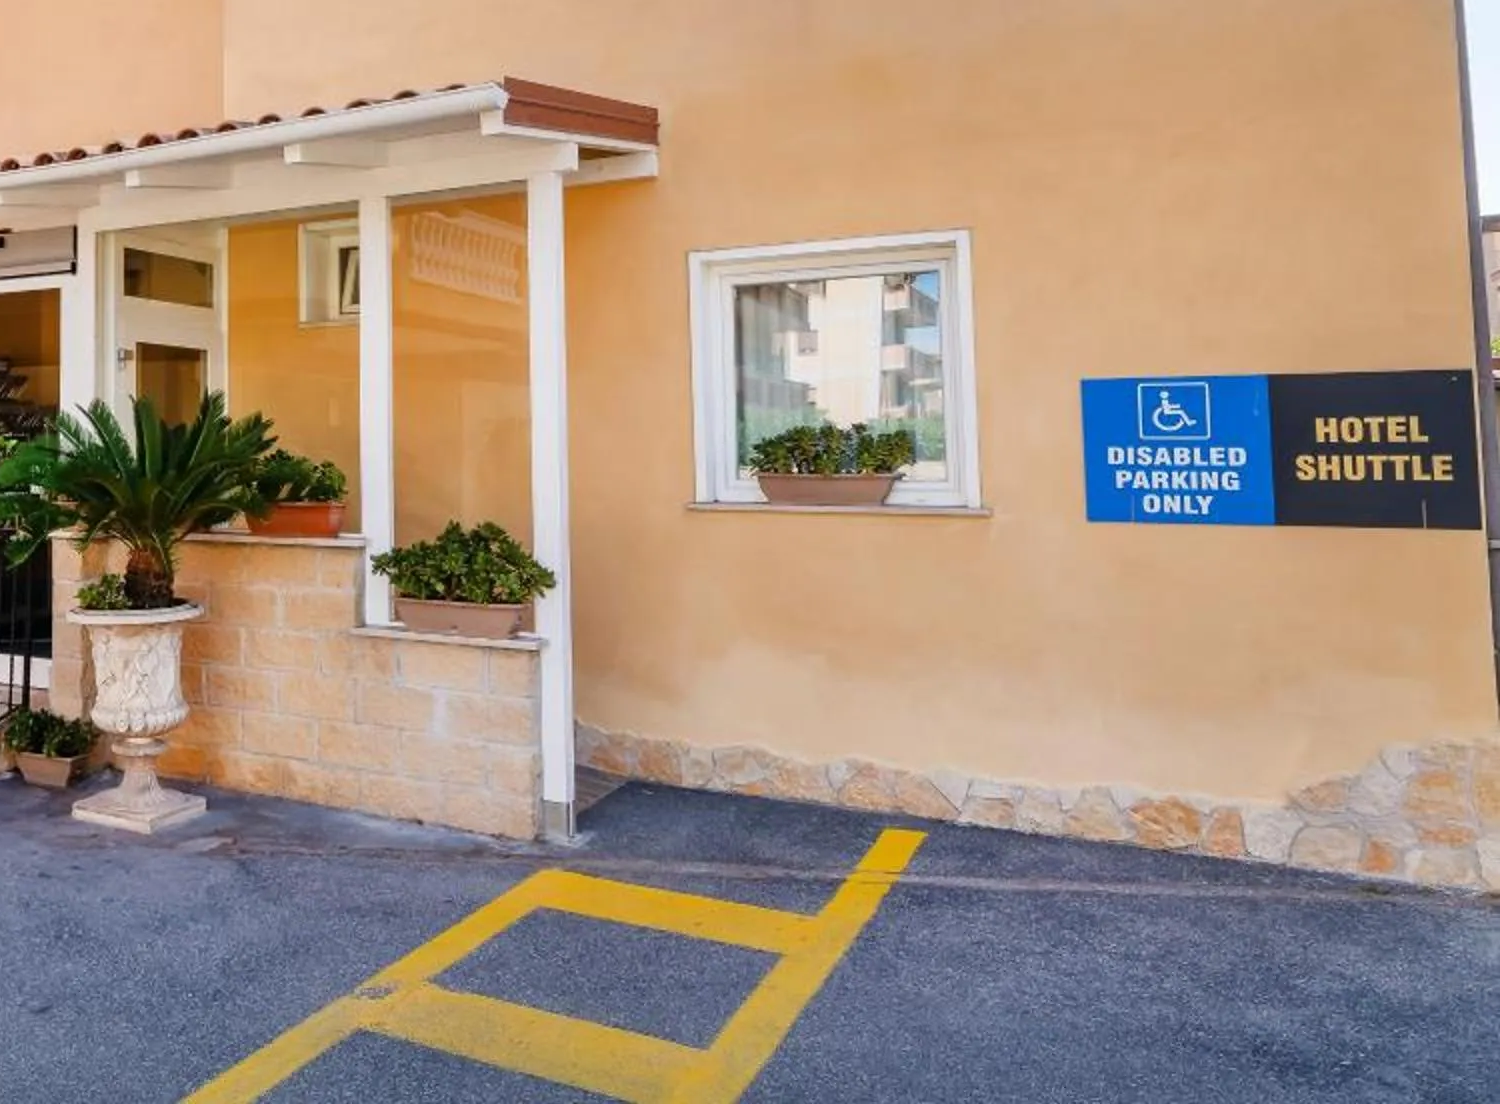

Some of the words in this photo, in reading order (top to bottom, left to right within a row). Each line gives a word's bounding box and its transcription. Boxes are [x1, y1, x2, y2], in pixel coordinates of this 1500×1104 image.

[1314, 415, 1429, 444] HOTEL
[1106, 446, 1248, 467] DISABLED
[1294, 453, 1455, 482] SHUTTLE
[1114, 469, 1242, 491] PARKING
[1142, 493, 1215, 516] ONLY
